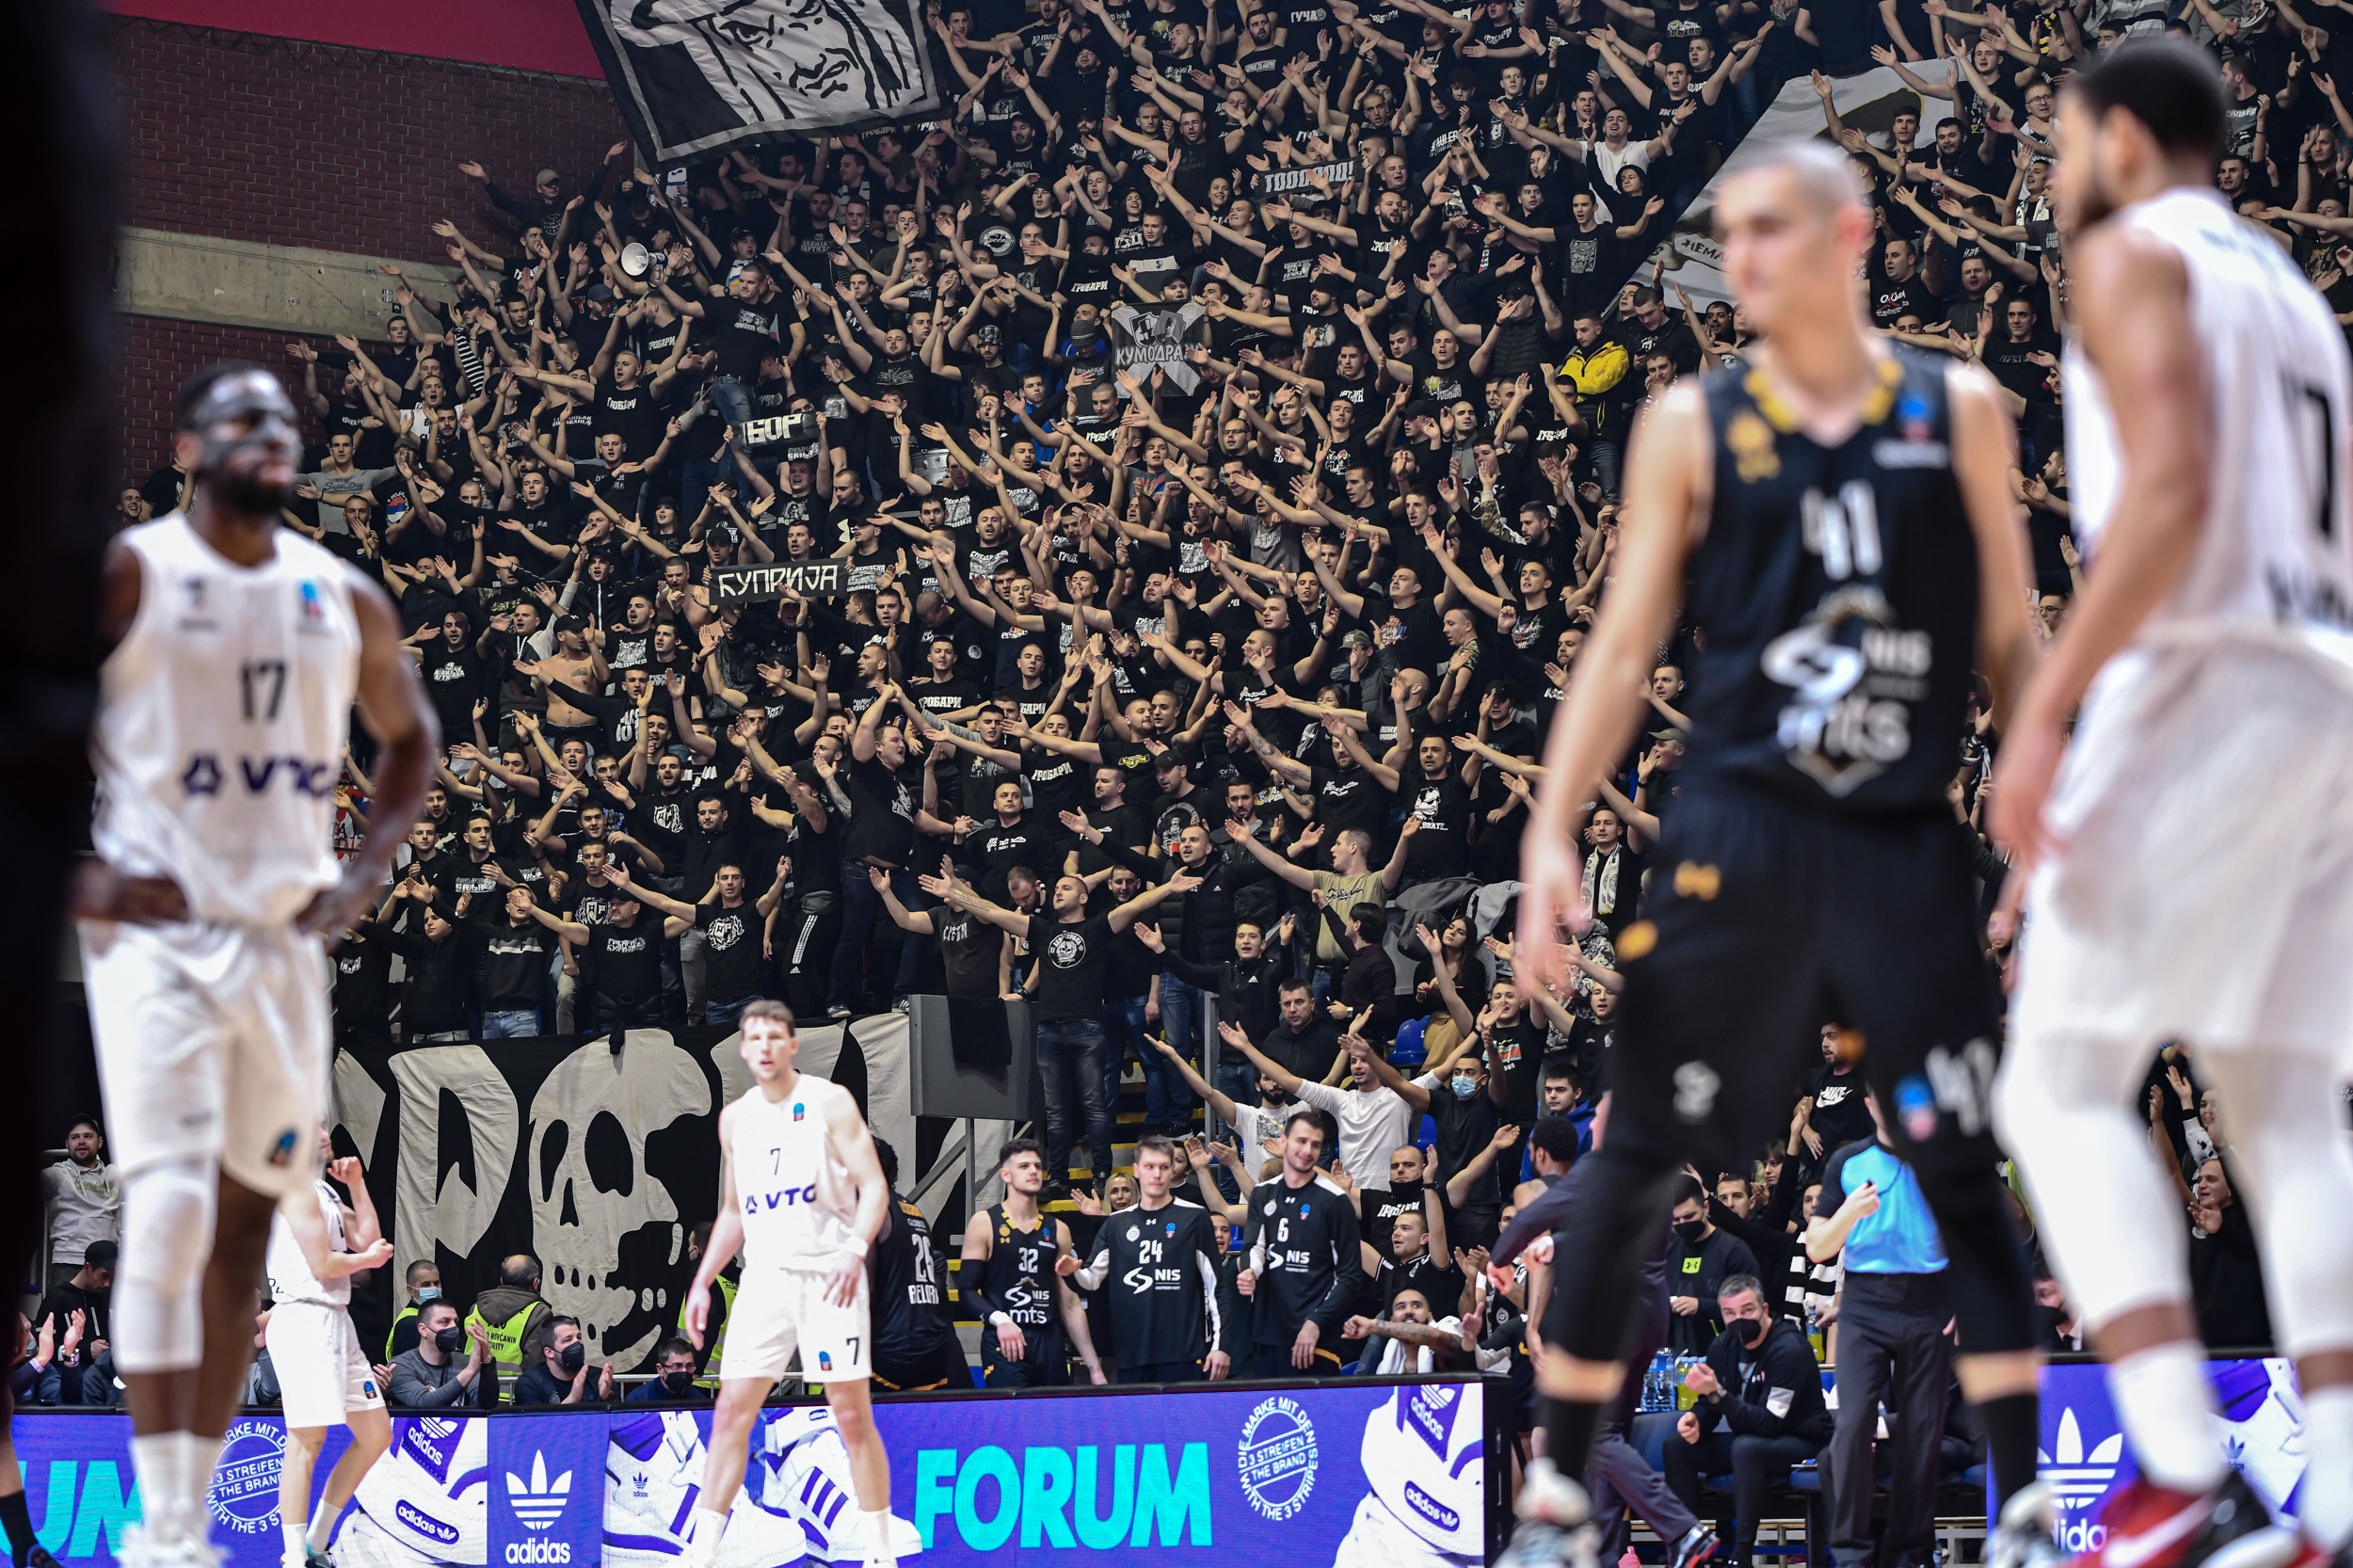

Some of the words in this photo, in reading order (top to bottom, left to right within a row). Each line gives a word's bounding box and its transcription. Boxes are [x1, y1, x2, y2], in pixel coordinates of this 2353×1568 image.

[240, 661, 286, 723] 17
[1824, 1086, 1849, 1102] NIKE
[770, 1147, 781, 1176] 7
[1276, 1217, 1289, 1242] 6
[1018, 1247, 1039, 1273] 32
[1139, 1240, 1163, 1265] 24
[1286, 1250, 1310, 1264] NIS
[1155, 1269, 1181, 1281] NIS
[1032, 1289, 1050, 1301] NIS
[1009, 1306, 1048, 1325] mts
[846, 1337, 860, 1366] 7
[1242, 1397, 1277, 1438] MARKE
[1278, 1397, 1300, 1414] MIT
[1297, 1410, 1317, 1444] DEN
[1411, 1396, 1445, 1441] adidas
[225, 1422, 252, 1444] RKE
[255, 1422, 279, 1439] MIT
[408, 1426, 444, 1466] adidas
[1248, 1454, 1256, 1466] 3
[1257, 1435, 1305, 1463] STREIFEN
[216, 1473, 224, 1483] 3
[1251, 1465, 1272, 1481] THE
[1273, 1452, 1306, 1475] BRAND
[219, 1482, 243, 1498] THE
[915, 1442, 1212, 1551] FORUM
[1240, 1472, 1262, 1512] WITH
[1261, 1503, 1283, 1521] THE
[1284, 1506, 1293, 1519] 3
[1292, 1448, 1319, 1512] STRIPES
[1406, 1487, 1441, 1520] adidas
[232, 1521, 256, 1534] THE
[259, 1520, 268, 1532] 3
[397, 1503, 436, 1535] adidas
[2053, 1517, 2108, 1553] ida
[505, 1537, 571, 1564] adidas
